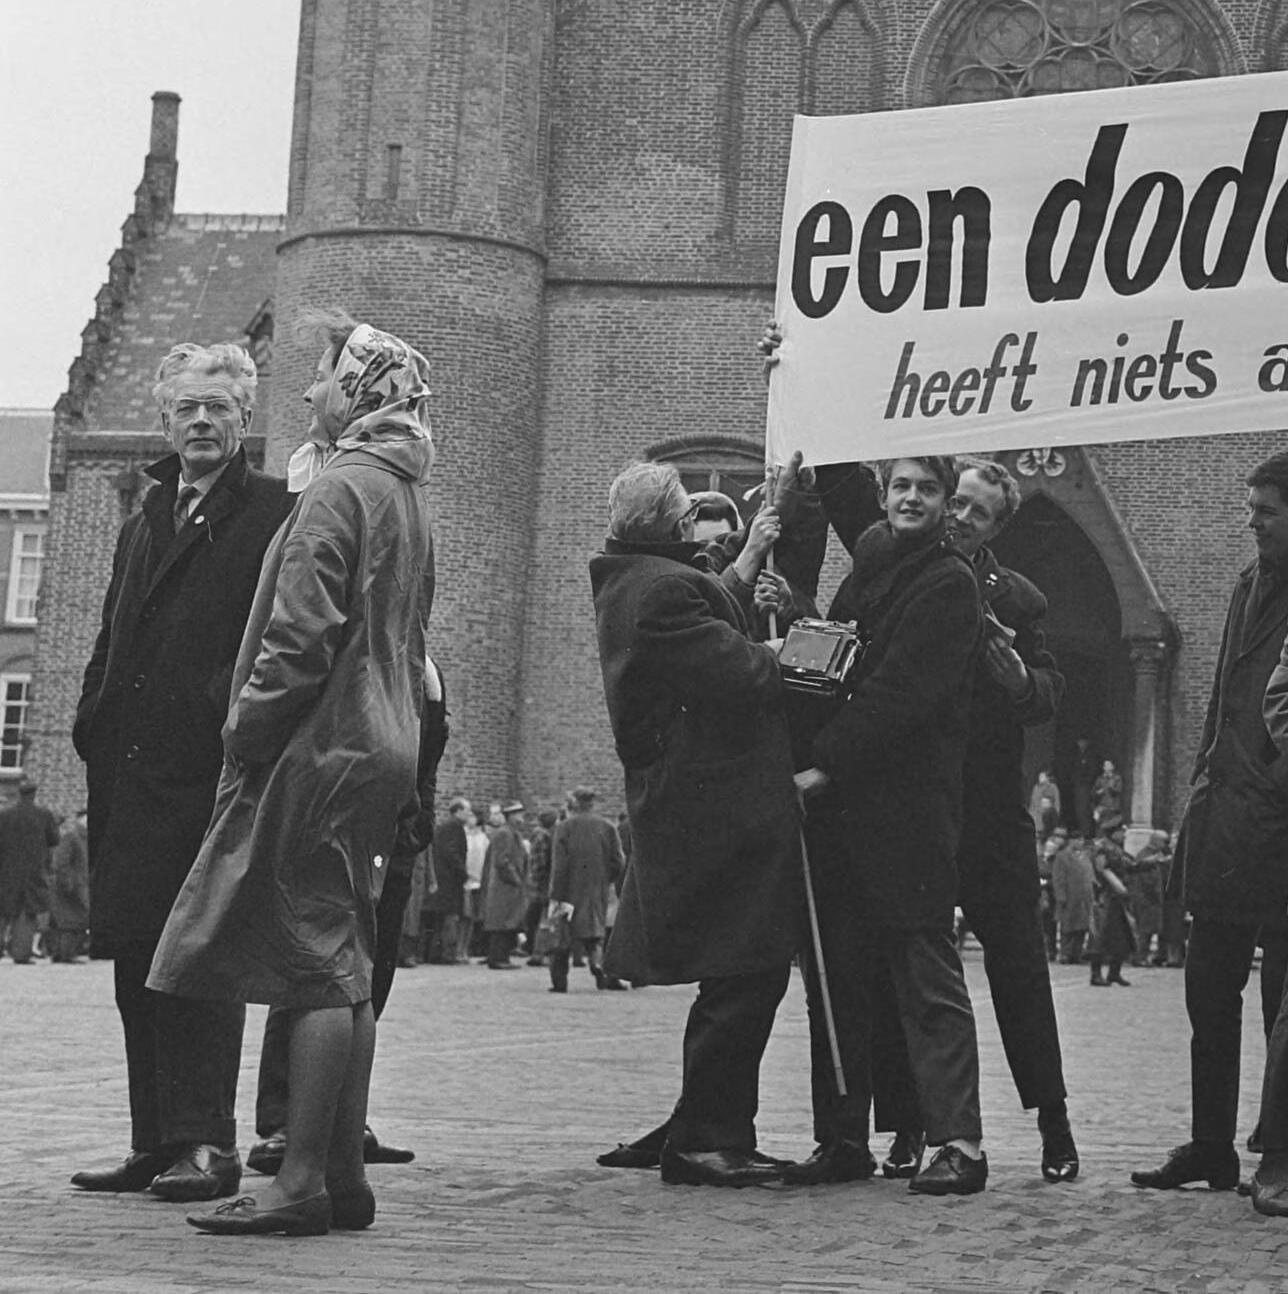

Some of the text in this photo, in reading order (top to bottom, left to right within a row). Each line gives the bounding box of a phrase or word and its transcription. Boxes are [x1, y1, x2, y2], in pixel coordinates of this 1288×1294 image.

[792, 186, 991, 319] een
[884, 332, 1038, 419] heeft
[1070, 318, 1217, 407] niets
